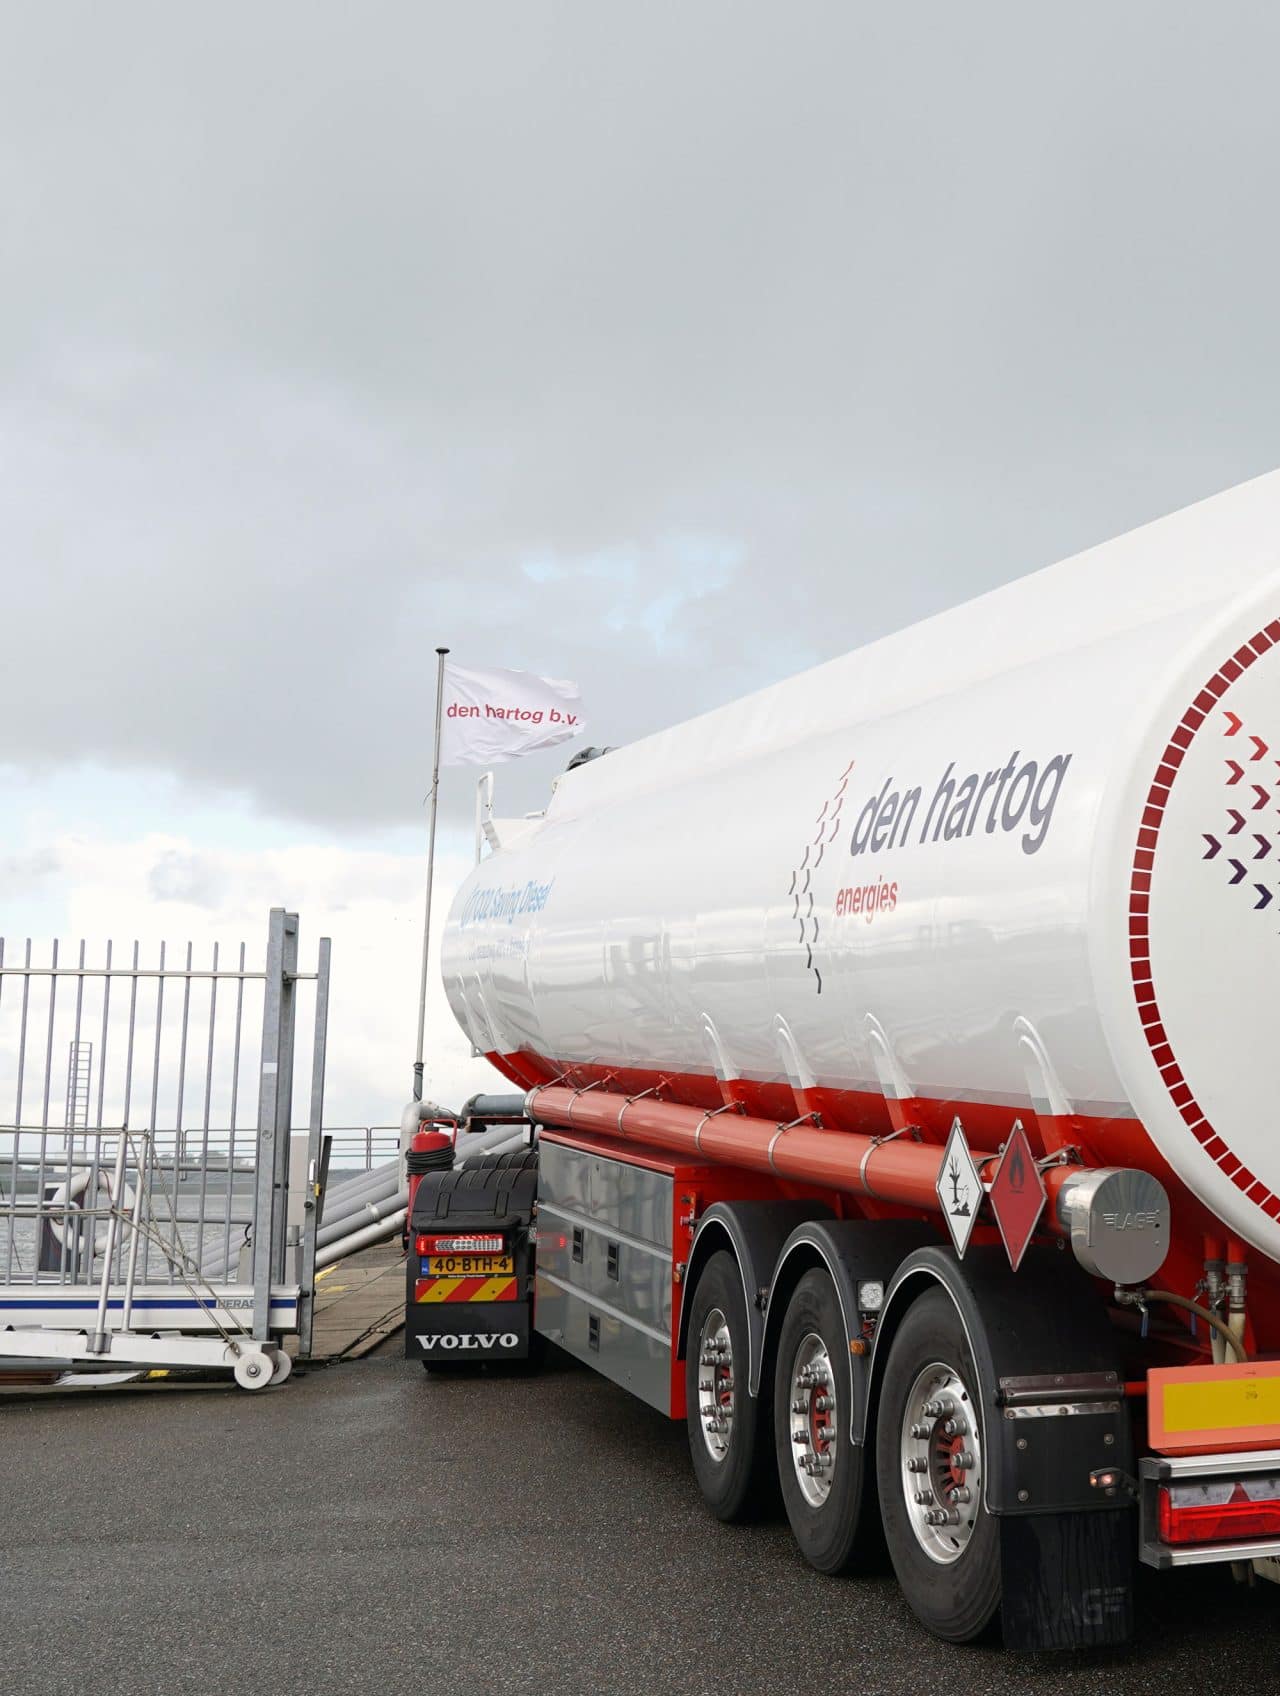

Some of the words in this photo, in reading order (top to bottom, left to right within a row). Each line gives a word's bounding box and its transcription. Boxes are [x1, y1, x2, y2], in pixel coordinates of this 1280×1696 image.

[447, 703, 480, 718] den
[485, 704, 544, 724] hartog
[549, 709, 579, 726] b.v.
[850, 777, 922, 857] den
[919, 750, 1073, 855] hartog
[836, 874, 899, 924] energies
[434, 1257, 508, 1272] 40-BTH-4
[416, 1333, 519, 1350] VOLVO
